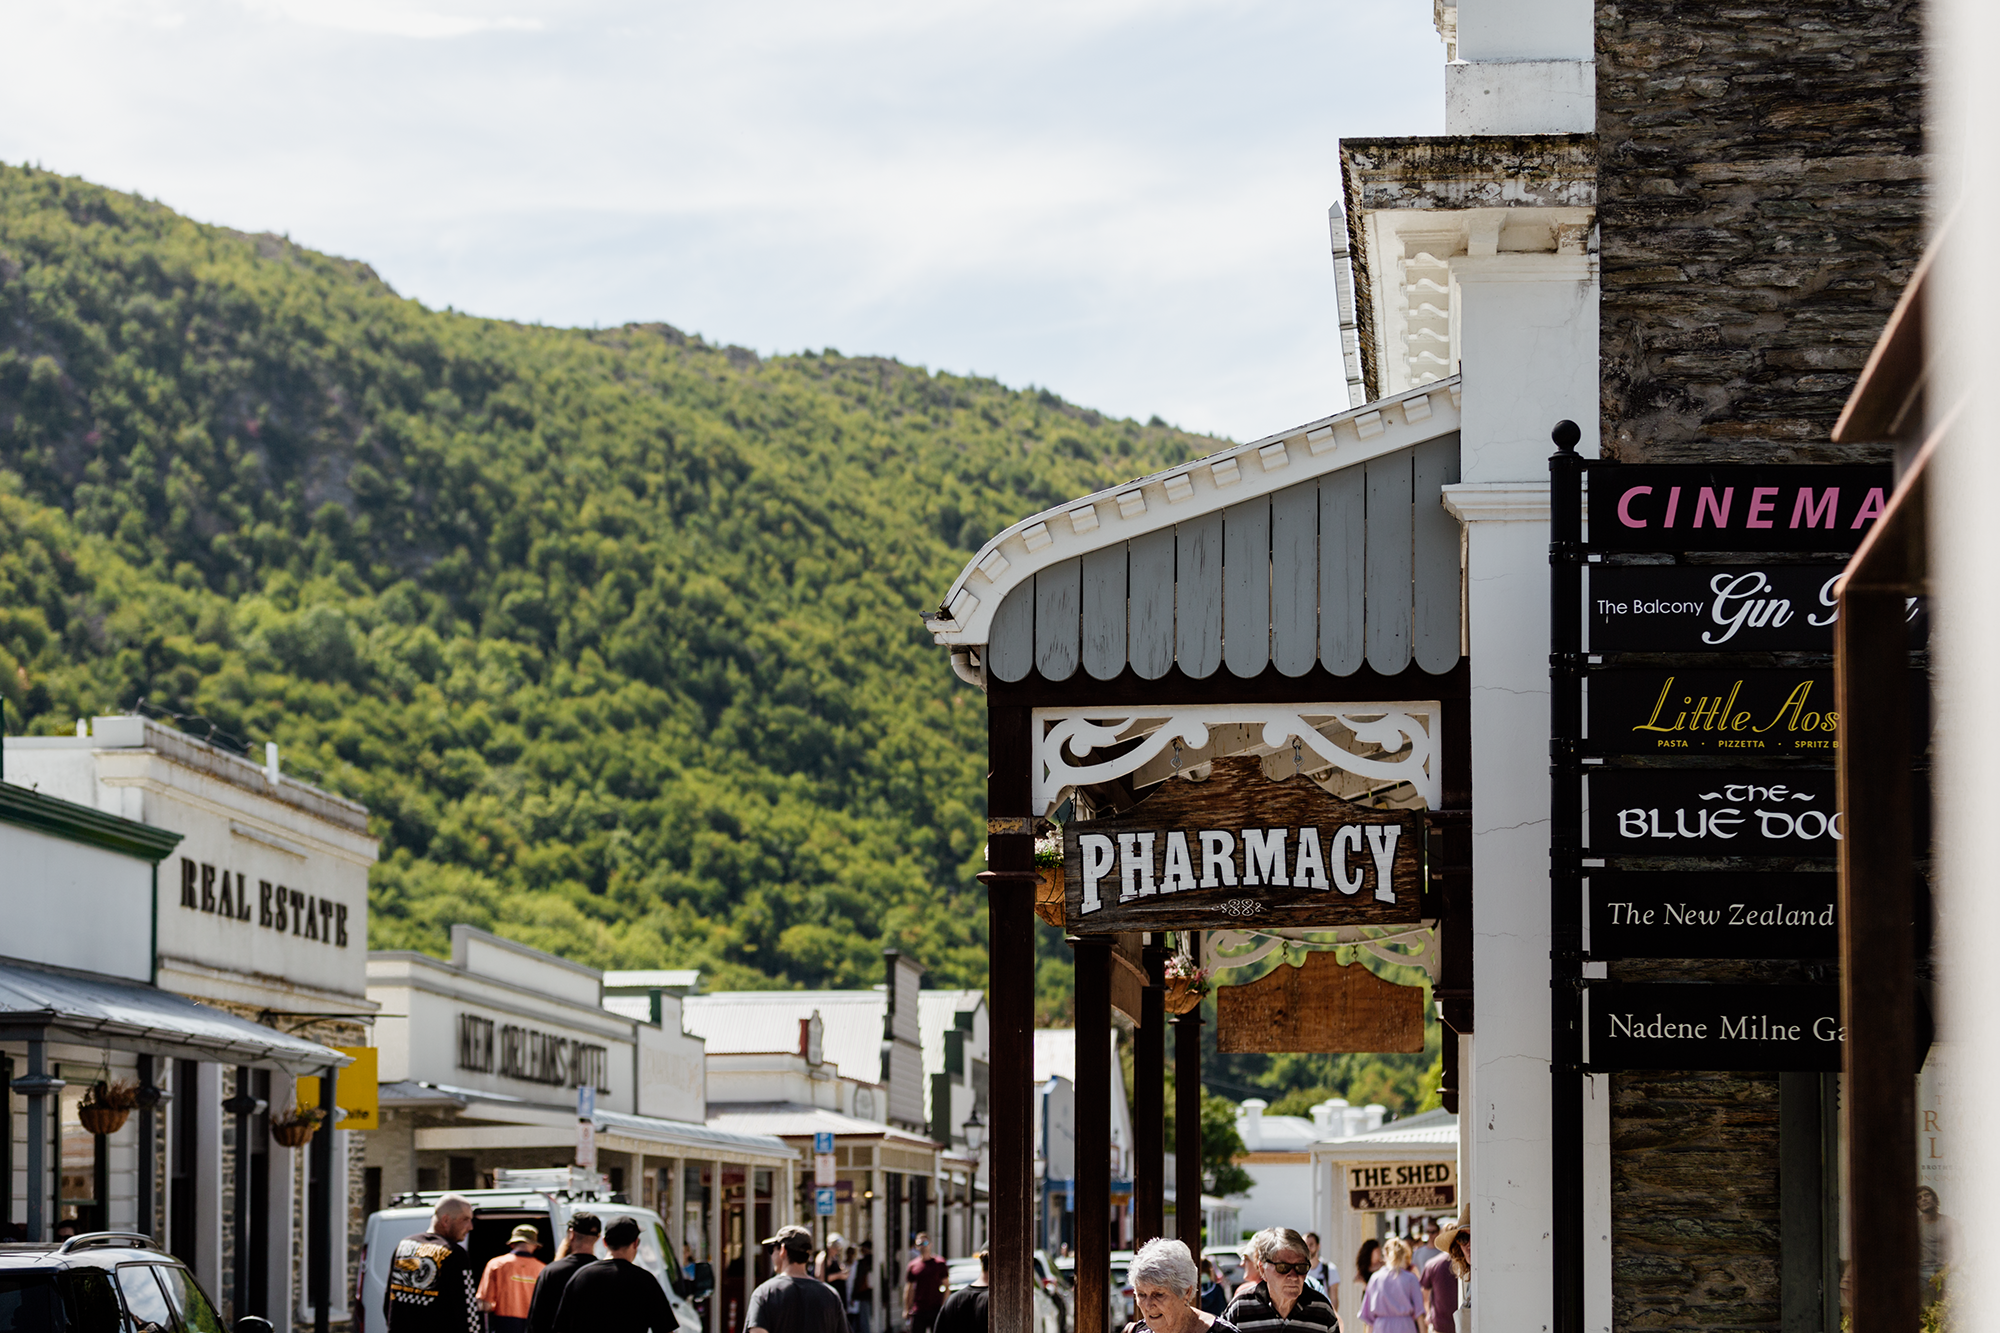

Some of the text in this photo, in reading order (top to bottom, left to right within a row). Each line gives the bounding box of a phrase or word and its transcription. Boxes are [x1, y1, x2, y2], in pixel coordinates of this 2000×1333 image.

[1597, 571, 1794, 645] The Balcony Gin
[1632, 677, 1751, 732] Little
[1657, 739, 1688, 748] PASTA
[1718, 740, 1765, 748] PIZZETTA
[1794, 740, 1829, 748] SPRITZ
[1617, 808, 1746, 839] BLUE
[1078, 824, 1401, 915] PHARMACY
[180, 856, 348, 948] REAL ESTATE
[1608, 902, 1835, 926] The New Zealand
[456, 1012, 494, 1074] NEW
[1608, 1013, 1707, 1039] Nadene
[1719, 1015, 1801, 1041] Milne
[1351, 1163, 1450, 1187] THE SHED
